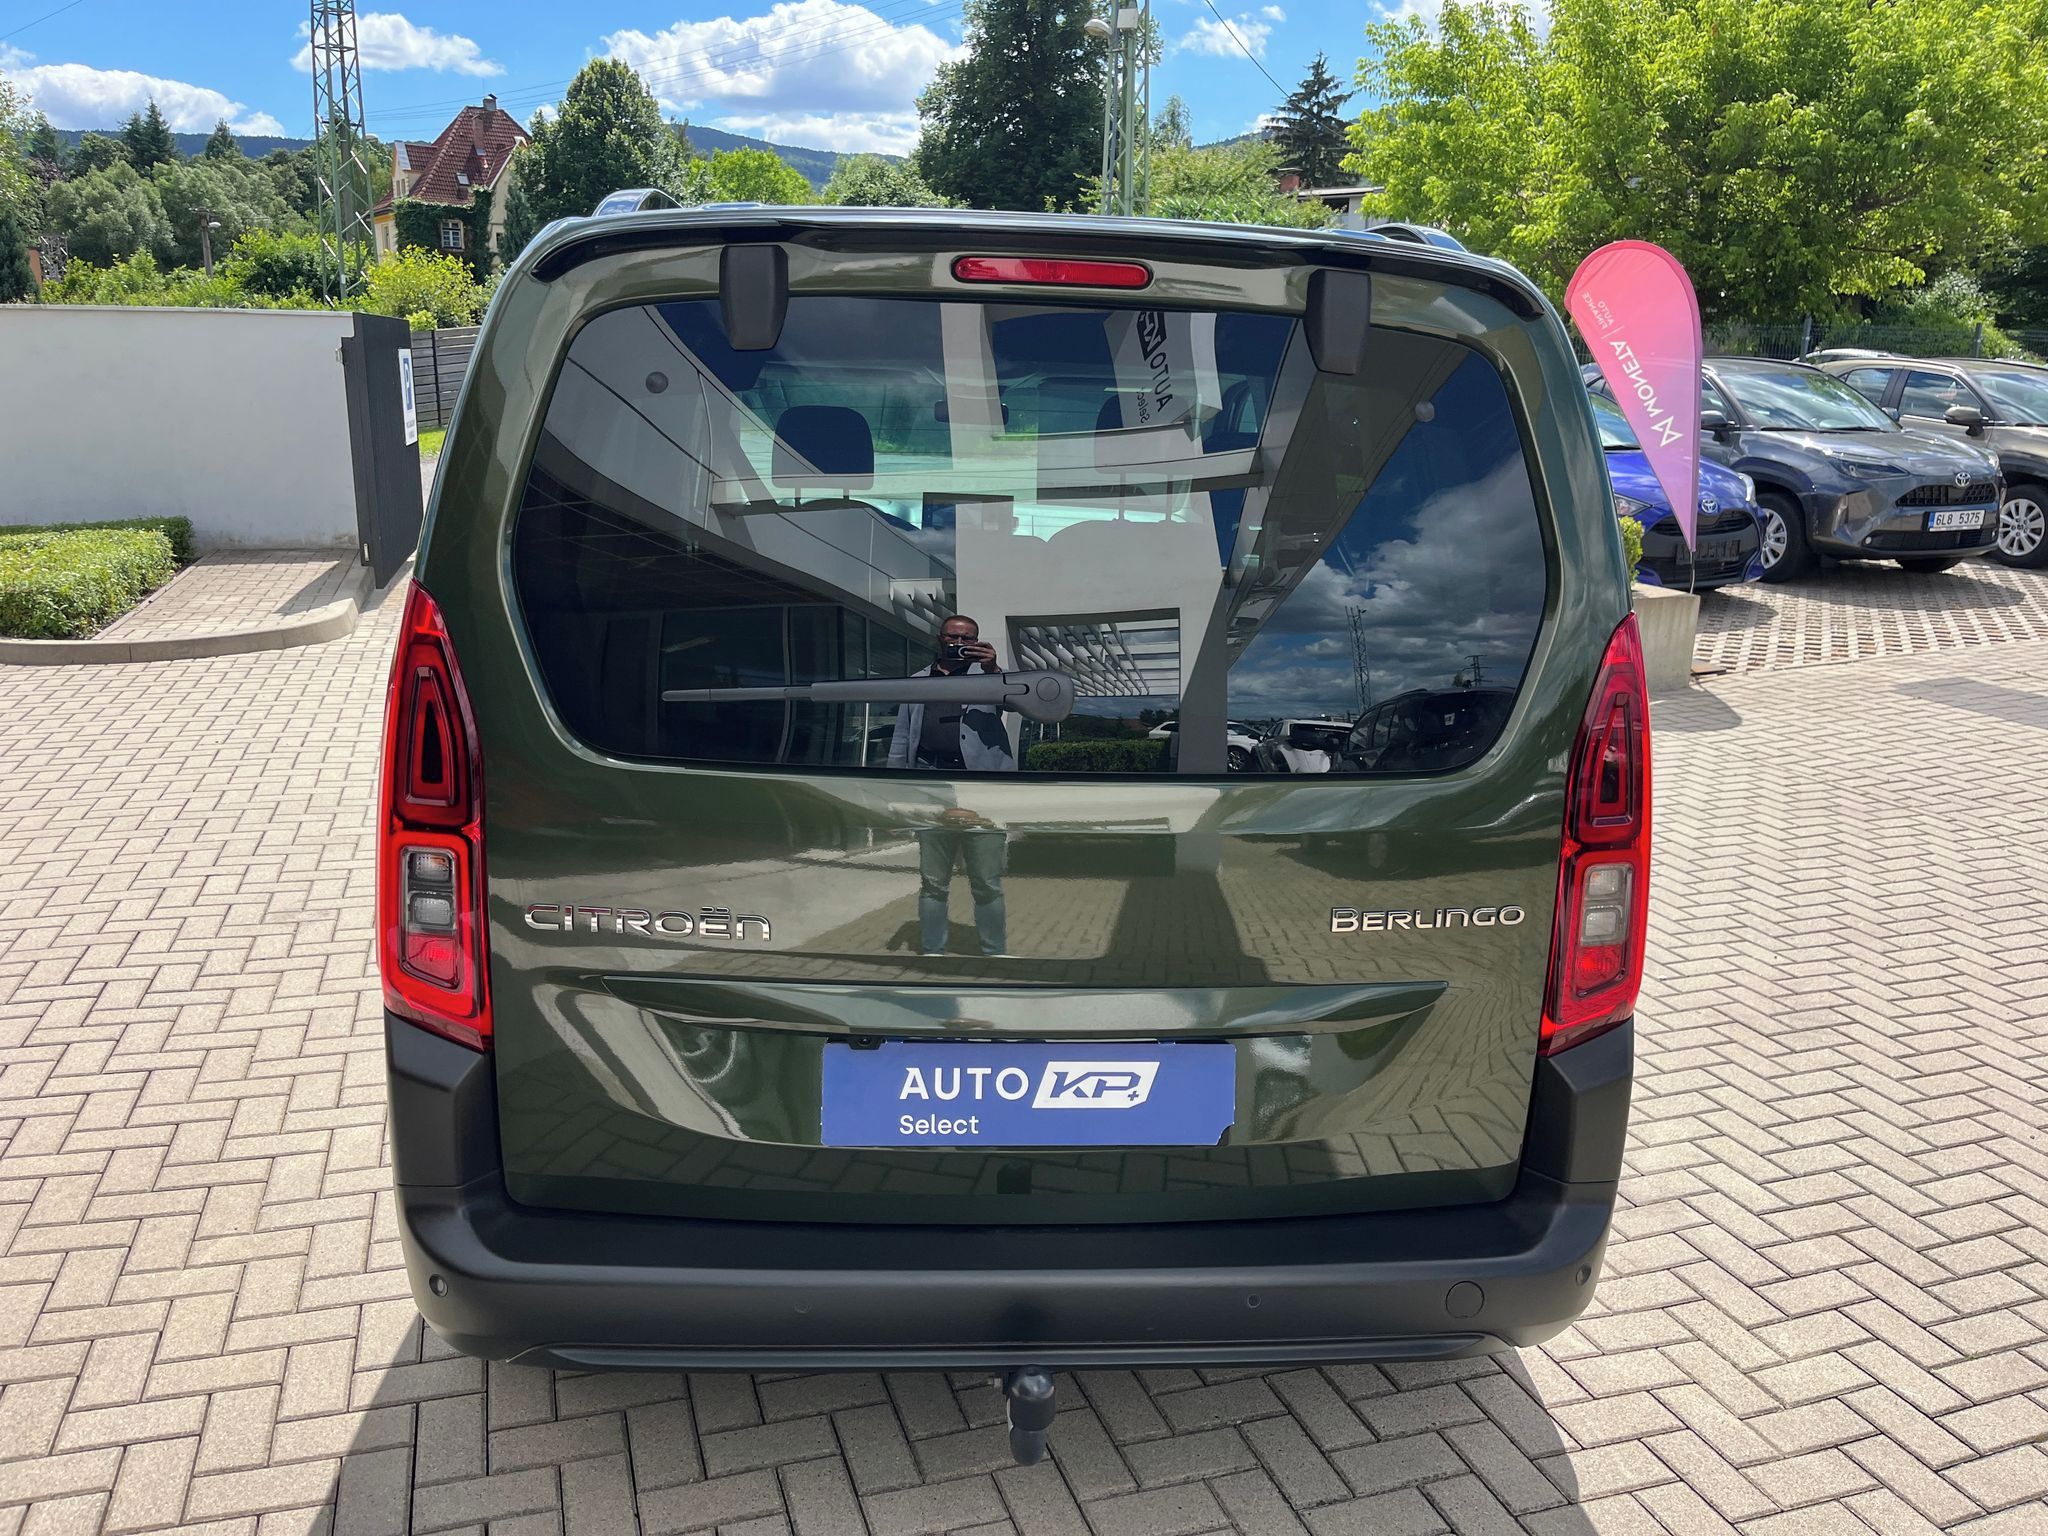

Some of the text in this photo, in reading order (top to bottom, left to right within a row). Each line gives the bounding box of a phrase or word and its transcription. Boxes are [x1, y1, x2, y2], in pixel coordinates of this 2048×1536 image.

[1935, 511, 1981, 526] 6L8 5375
[1331, 905, 1525, 933] BERLINGO
[899, 1067, 1029, 1100] AUTO
[899, 1114, 979, 1135] Select
